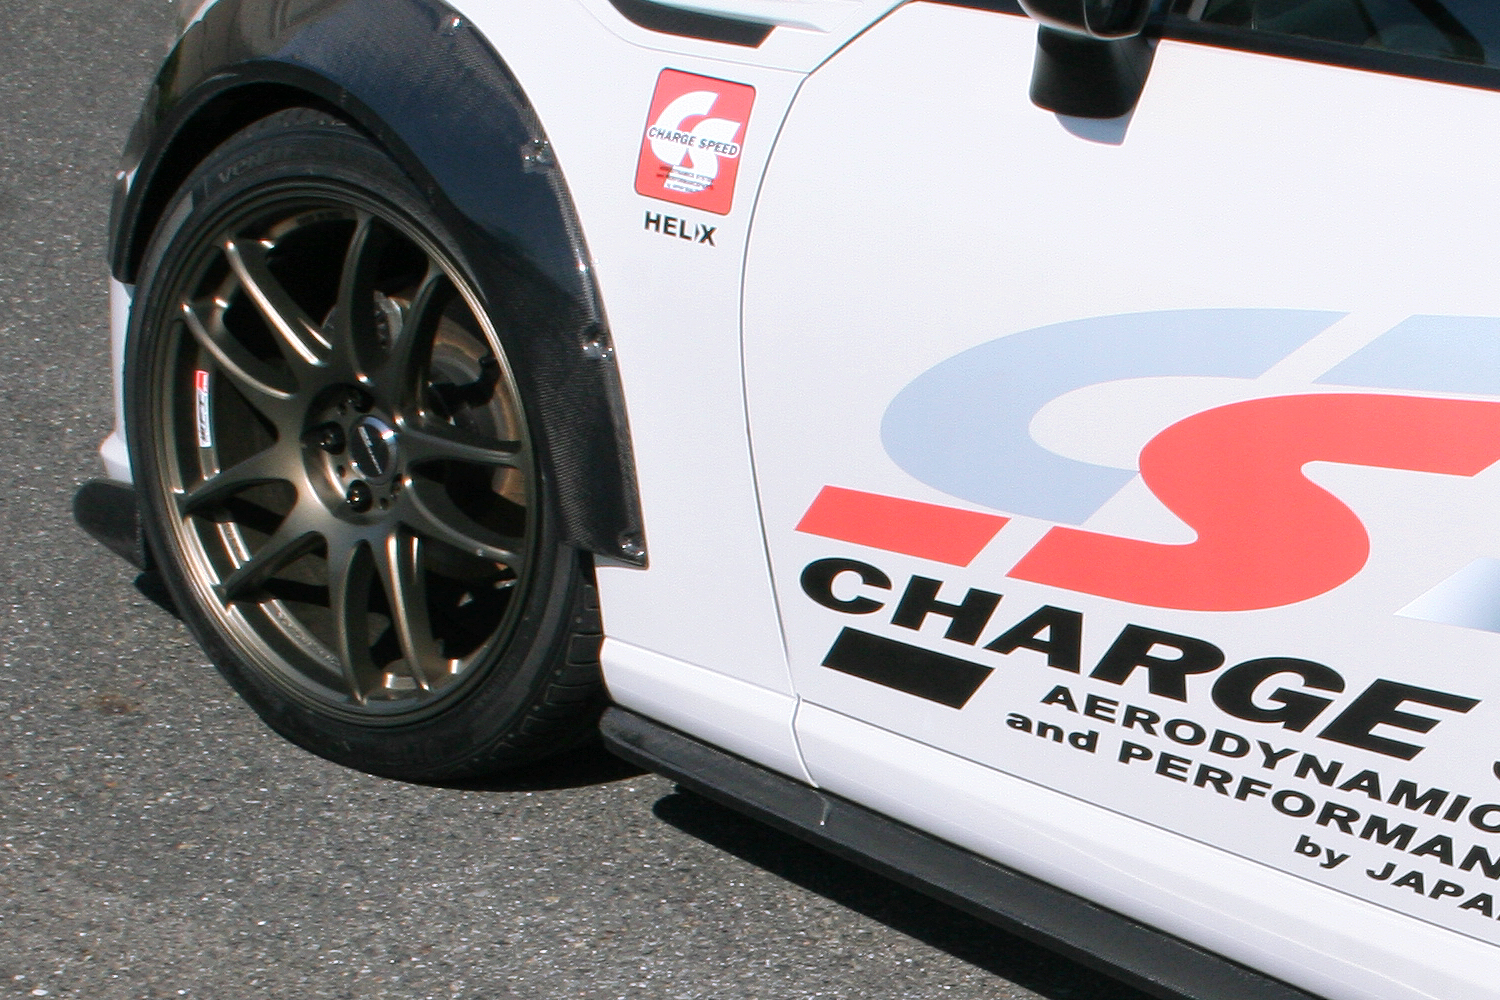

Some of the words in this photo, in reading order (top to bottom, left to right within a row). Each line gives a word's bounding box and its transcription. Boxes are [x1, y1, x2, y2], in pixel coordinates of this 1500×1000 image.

[649, 126, 696, 147] CHARGE
[698, 138, 738, 156] SPEED
[800, 557, 1481, 761] CHARGE
[1006, 712, 1099, 754] and
[1294, 834, 1350, 869] by
